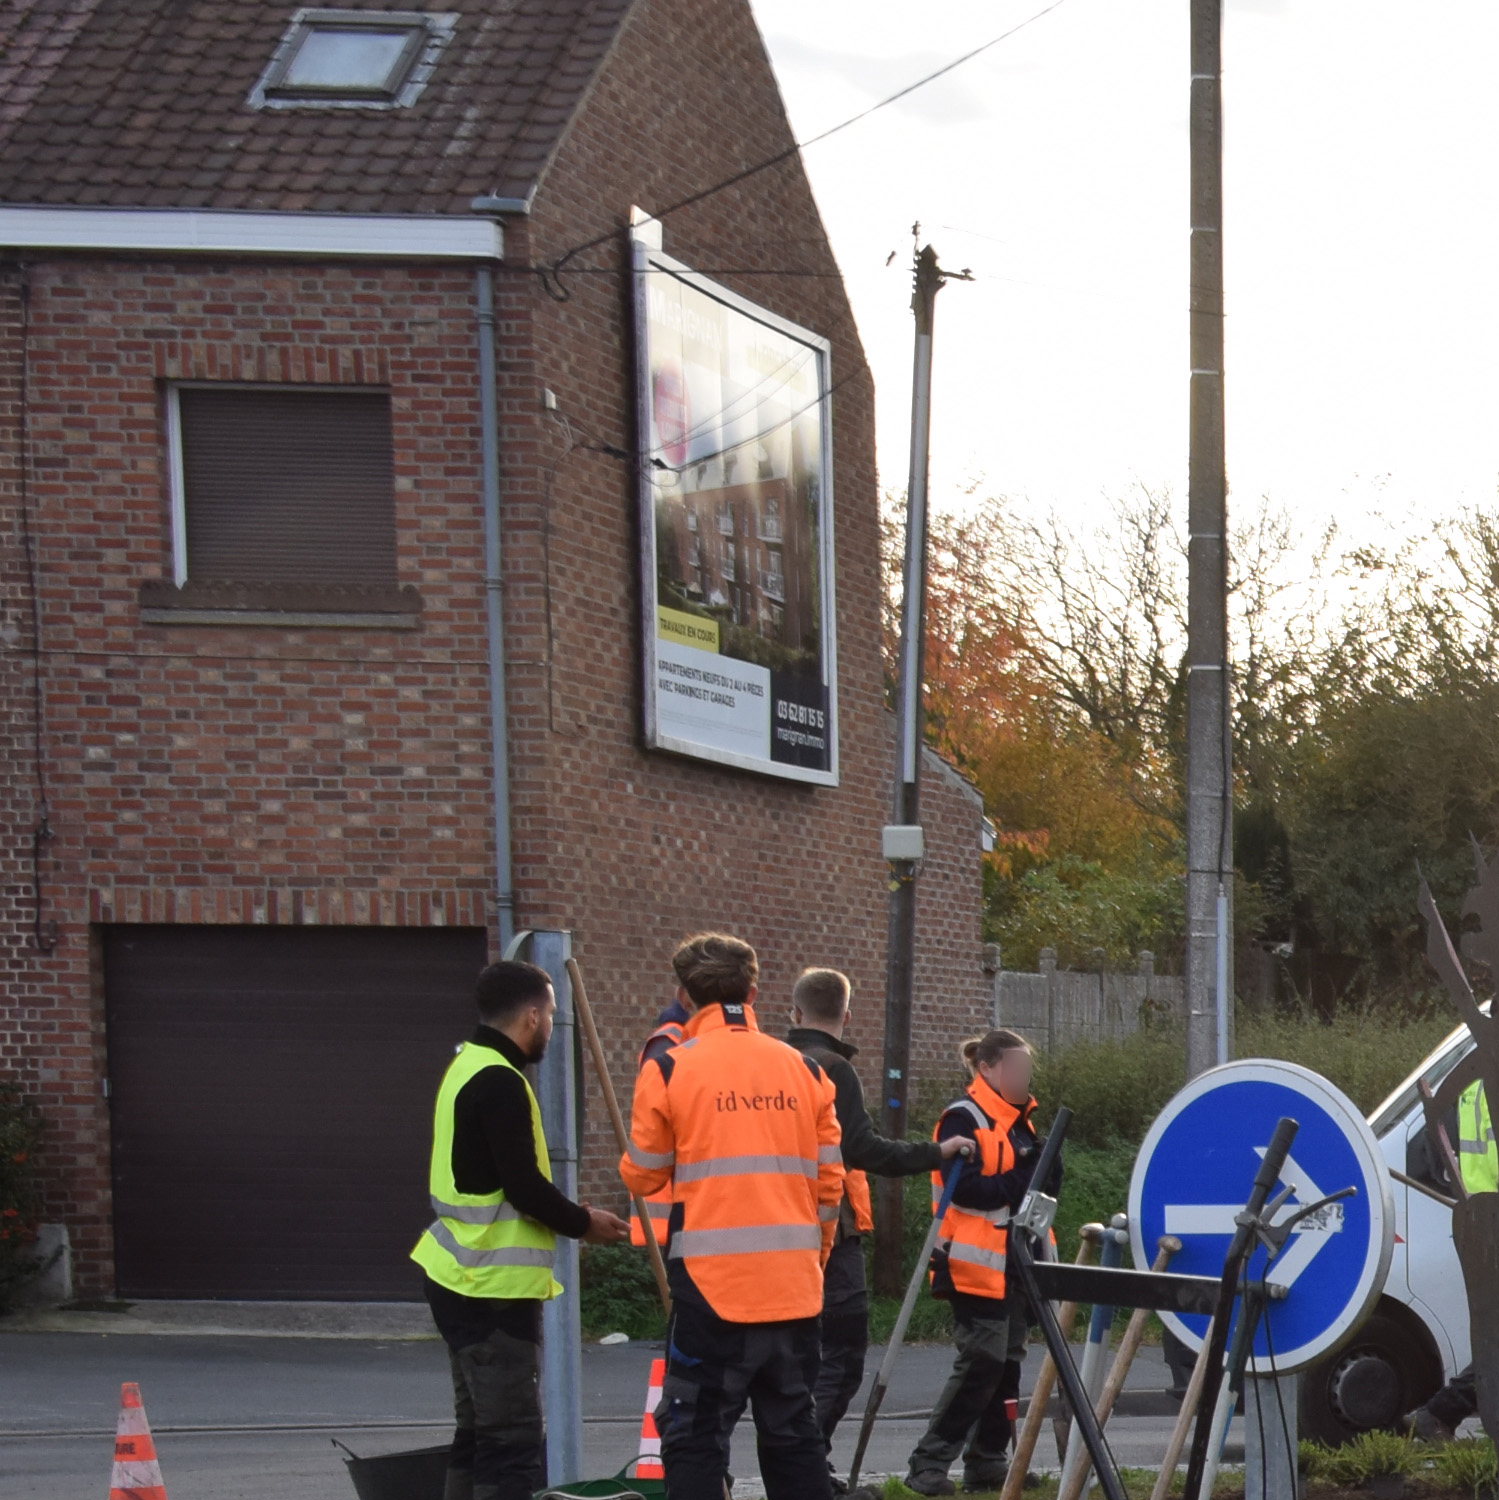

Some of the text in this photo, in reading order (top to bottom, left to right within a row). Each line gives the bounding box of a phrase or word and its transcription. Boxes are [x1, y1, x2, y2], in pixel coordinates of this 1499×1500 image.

[660, 618, 716, 644] TRAVAUX EN COURS
[658, 660, 702, 681] APPARTEMENTS
[703, 670, 721, 686] NEUFS
[721, 676, 729, 688] DU
[734, 680, 742, 692] AU
[659, 678, 735, 708] AVEC PARKINGS ET GARAGES
[778, 700, 824, 729] 03 62 81 15 15
[777, 726, 825, 750] marignan.immo
